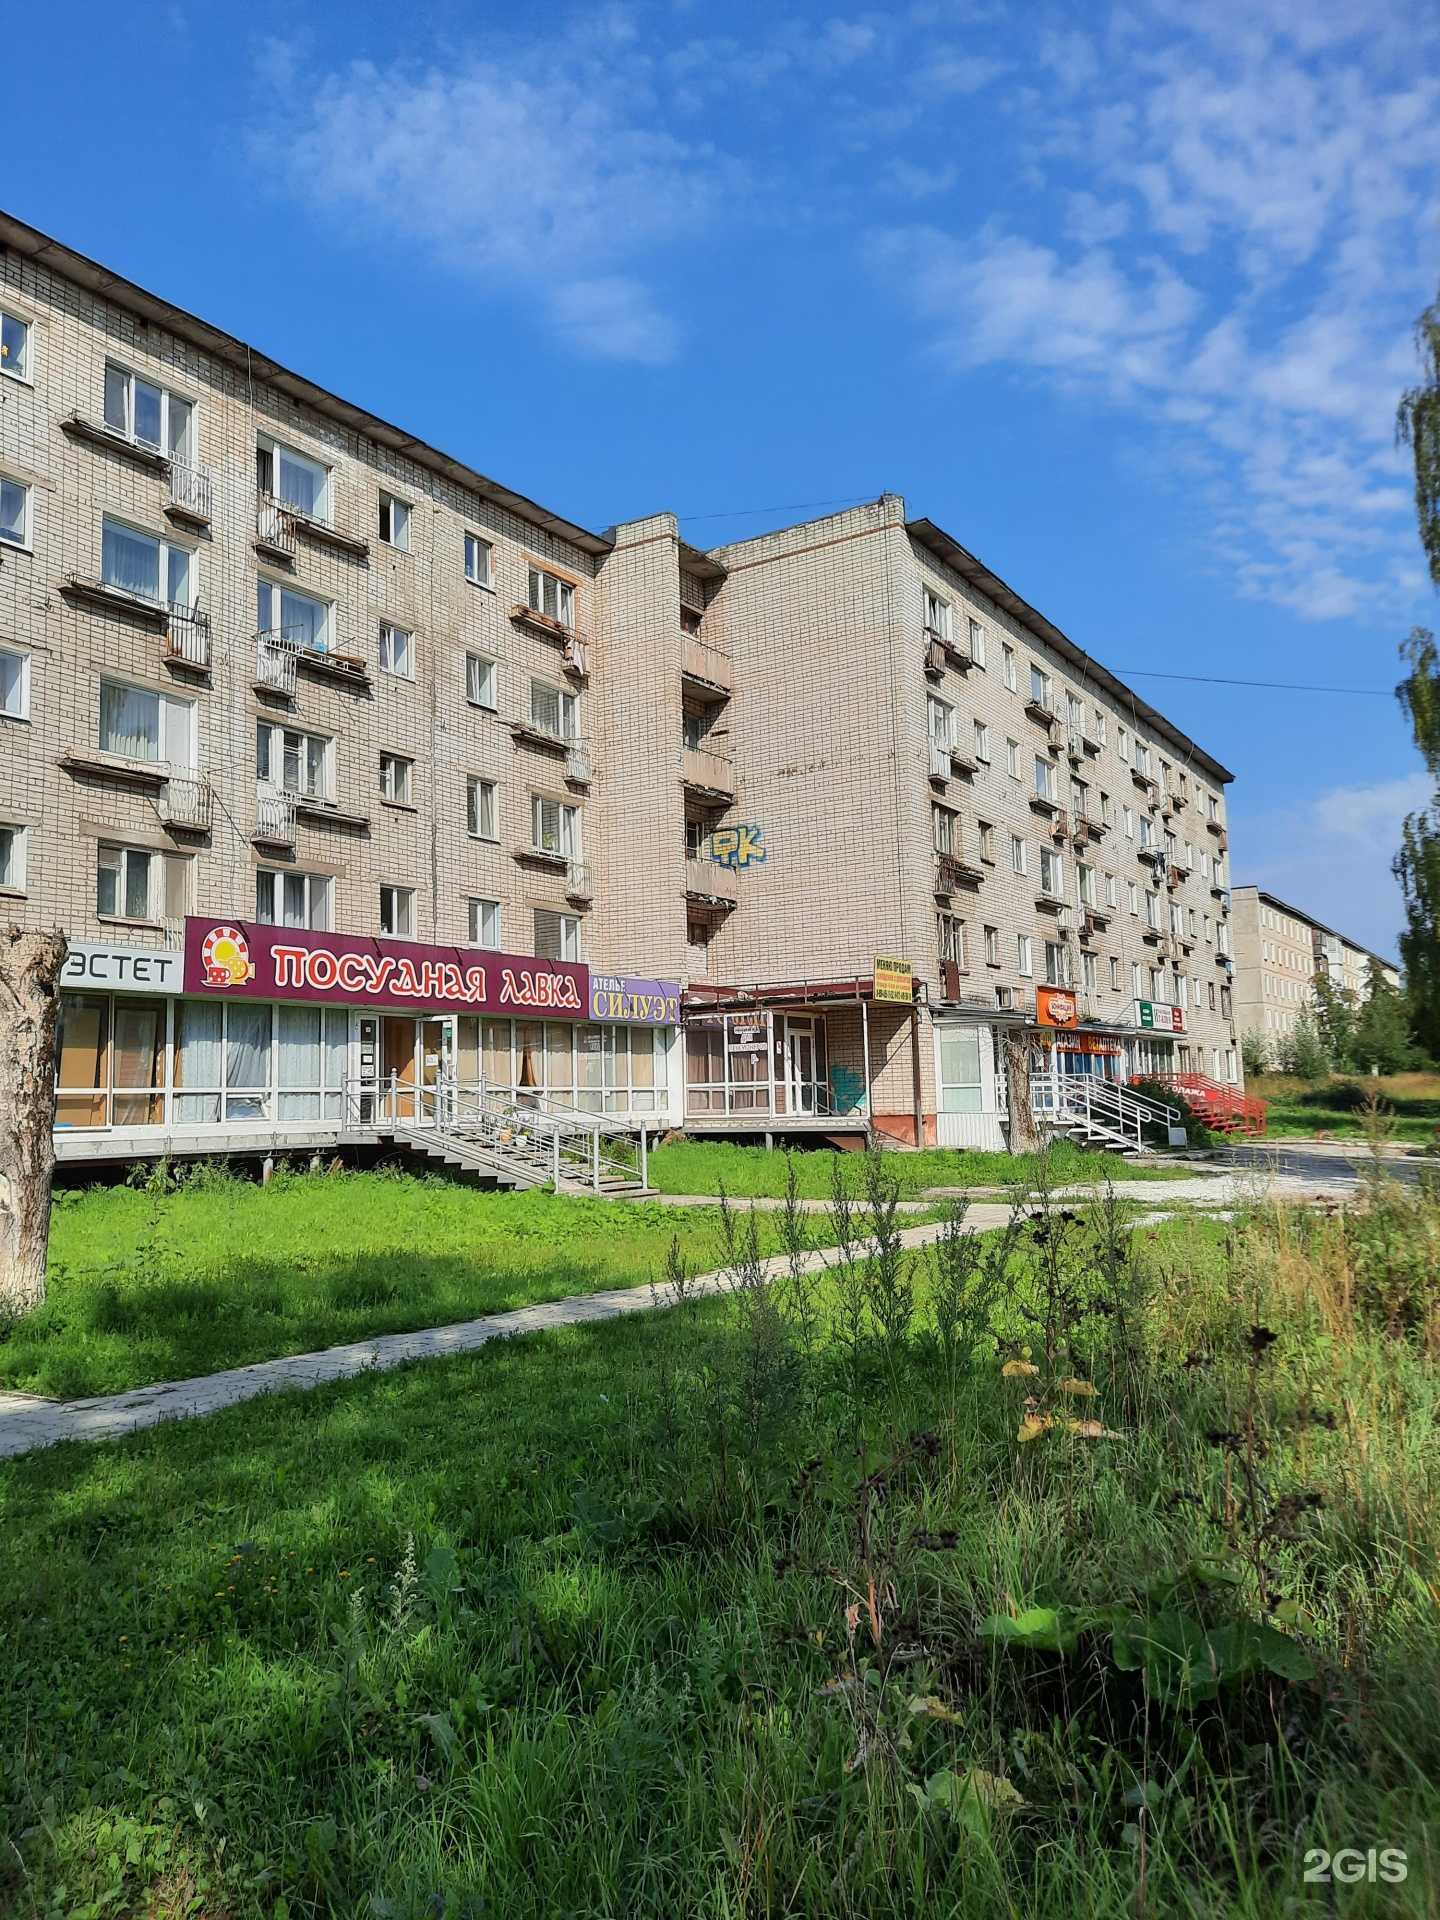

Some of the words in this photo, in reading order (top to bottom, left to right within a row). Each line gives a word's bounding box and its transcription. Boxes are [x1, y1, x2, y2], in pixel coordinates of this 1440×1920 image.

[66, 951, 173, 983] ЭСТЕТ
[271, 945, 487, 1003] ПОСУДНАЯ
[500, 968, 582, 1009] ЛАВКА
[592, 977, 626, 992] АТЕЛЬЕ
[592, 991, 678, 1022] СИЛУЭТ
